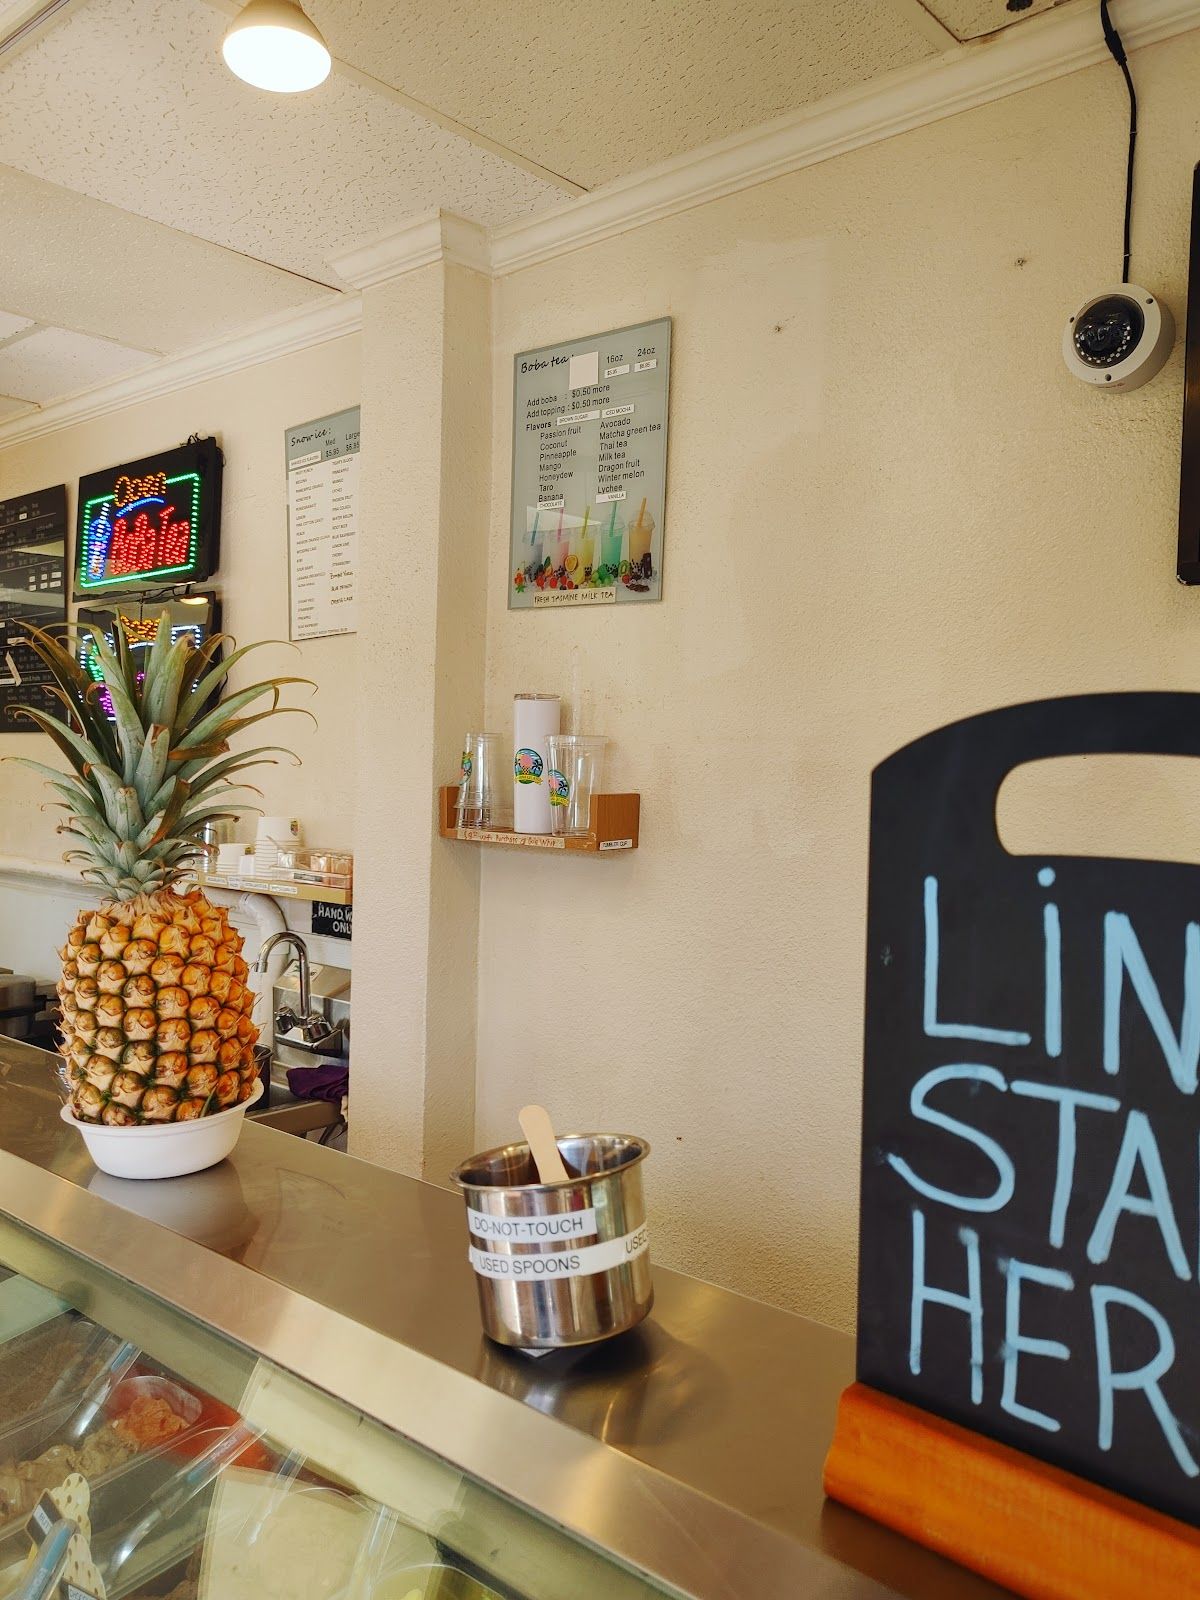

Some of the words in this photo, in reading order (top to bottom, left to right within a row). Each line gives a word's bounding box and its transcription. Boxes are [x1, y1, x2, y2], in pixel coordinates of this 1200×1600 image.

[606, 354, 624, 364] 16oz
[637, 347, 656, 358] 24oz
[521, 360, 550, 374] Boba
[527, 399, 541, 408] Add
[541, 396, 558, 405] boba
[572, 387, 592, 399] $0.50
[593, 384, 611, 395] more
[527, 409, 540, 419] Add
[540, 404, 566, 418] topping
[572, 399, 591, 411] $0.50
[593, 397, 611, 407] more
[526, 421, 553, 432] Flavors
[600, 417, 631, 430] Avocado
[541, 430, 568, 441] Passion
[568, 425, 582, 436] fruit
[600, 430, 625, 441] Matcha
[626, 426, 648, 438] green
[649, 422, 662, 432] tea
[291, 435, 312, 447] Snow
[541, 440, 568, 451] Coconut
[600, 440, 615, 451] Thai
[616, 439, 628, 448] tea
[599, 452, 614, 462] Milk
[614, 450, 626, 460] tea
[540, 462, 562, 474] Mango
[599, 463, 624, 475] Dragon
[625, 458, 641, 470] fruit
[539, 471, 574, 483] Honeydew
[598, 472, 622, 483] Winter
[623, 469, 645, 480] melon
[540, 484, 555, 493] Taro
[597, 484, 623, 495] Lychee
[538, 493, 564, 502] Banana
[318, 903, 344, 921] HAND
[474, 1216, 583, 1236] DO-NOT-TOUCH
[480, 1255, 509, 1273] USED
[512, 1254, 581, 1275] SPOONS
